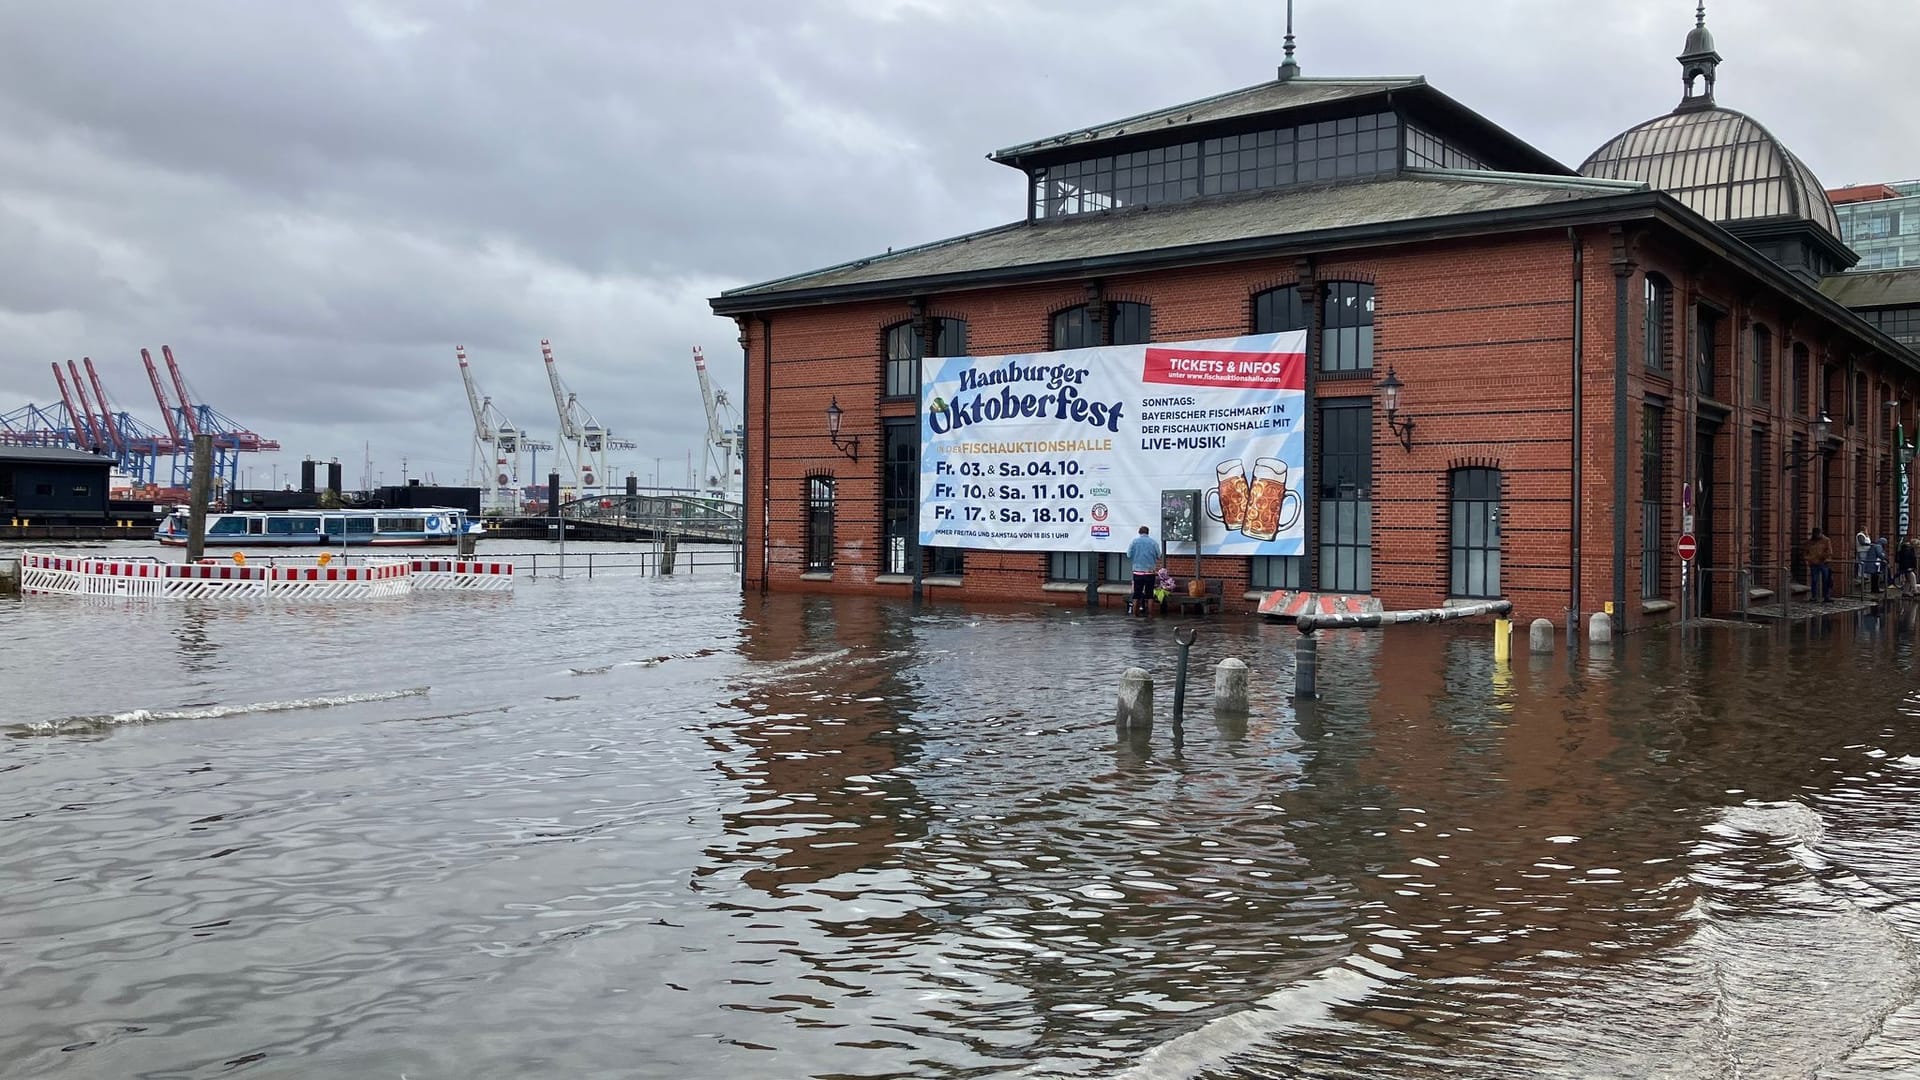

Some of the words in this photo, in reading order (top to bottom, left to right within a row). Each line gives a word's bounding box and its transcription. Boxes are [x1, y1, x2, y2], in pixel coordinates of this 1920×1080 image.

[1169, 358, 1224, 373] TICKETS
[1226, 361, 1236, 373] &
[1239, 361, 1281, 374] INFOS
[959, 360, 1090, 392] Hamburger
[1187, 373, 1281, 383] www.fischauktionshalle.com
[929, 385, 1125, 435] Oktoberfest
[1142, 397, 1195, 407] SONNTAGS:
[1141, 410, 1206, 421] BAYERISCHER
[1208, 406, 1271, 418] FISCHMARKT
[1273, 404, 1285, 413] IN
[1142, 425, 1160, 434] DER
[1162, 419, 1270, 433] FISCHAUKTIONSHALLE
[1272, 418, 1291, 428] MIT
[962, 439, 1112, 454] FISCHAUKTIONSHALLE
[1141, 436, 1226, 450] LIVE-MUSIK!
[936, 461, 955, 475] Fr.
[960, 462, 985, 477] 03.
[987, 464, 996, 475] &
[999, 462, 1025, 477] Sa.
[935, 483, 956, 498] Fr.
[962, 484, 986, 499] 10.
[988, 487, 996, 498] &
[999, 485, 1026, 500] Sa.
[935, 506, 955, 520] Fr.
[964, 507, 986, 521] 17.
[989, 510, 997, 520] &
[999, 508, 1026, 522] Sa.
[1032, 507, 1084, 523] 18.10.
[991, 531, 1018, 539] SAMSTAG
